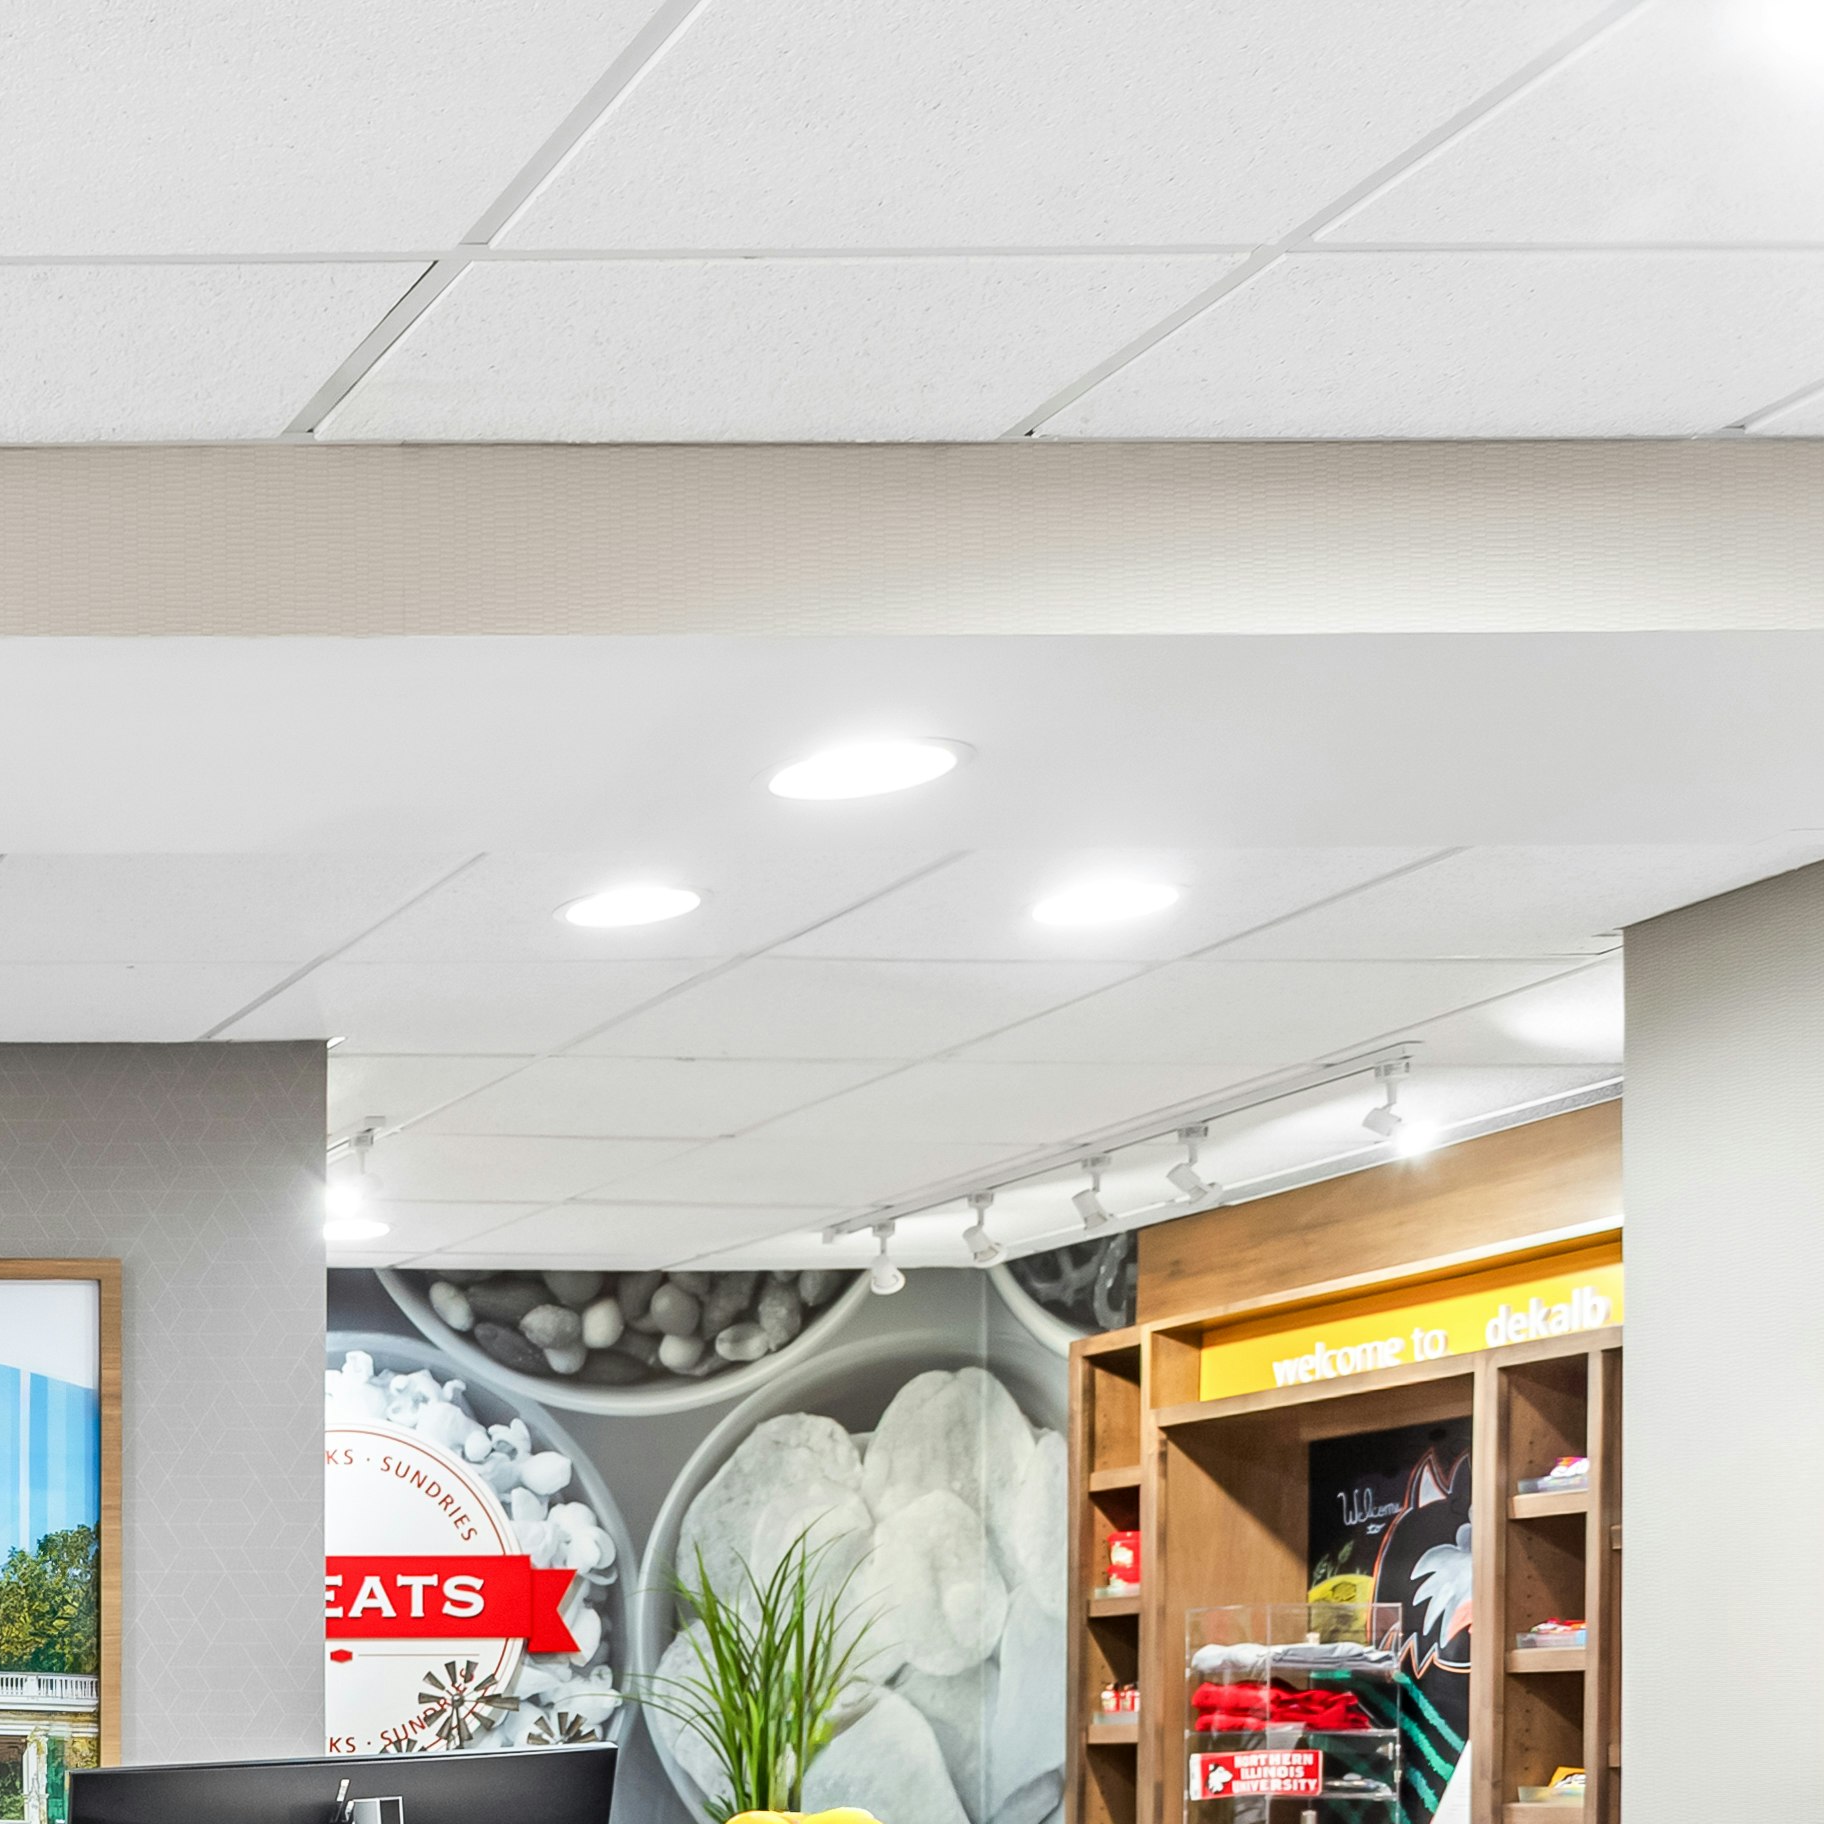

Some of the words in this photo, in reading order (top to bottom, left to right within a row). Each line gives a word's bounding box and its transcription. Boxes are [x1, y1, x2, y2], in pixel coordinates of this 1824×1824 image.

[1272, 1338, 1404, 1387] welcome
[1411, 1327, 1448, 1361] to
[1485, 1286, 1612, 1348] dekalb
[381, 1455, 478, 1541] SUNDRIES
[1240, 1766, 1304, 1780] ILLINOIS
